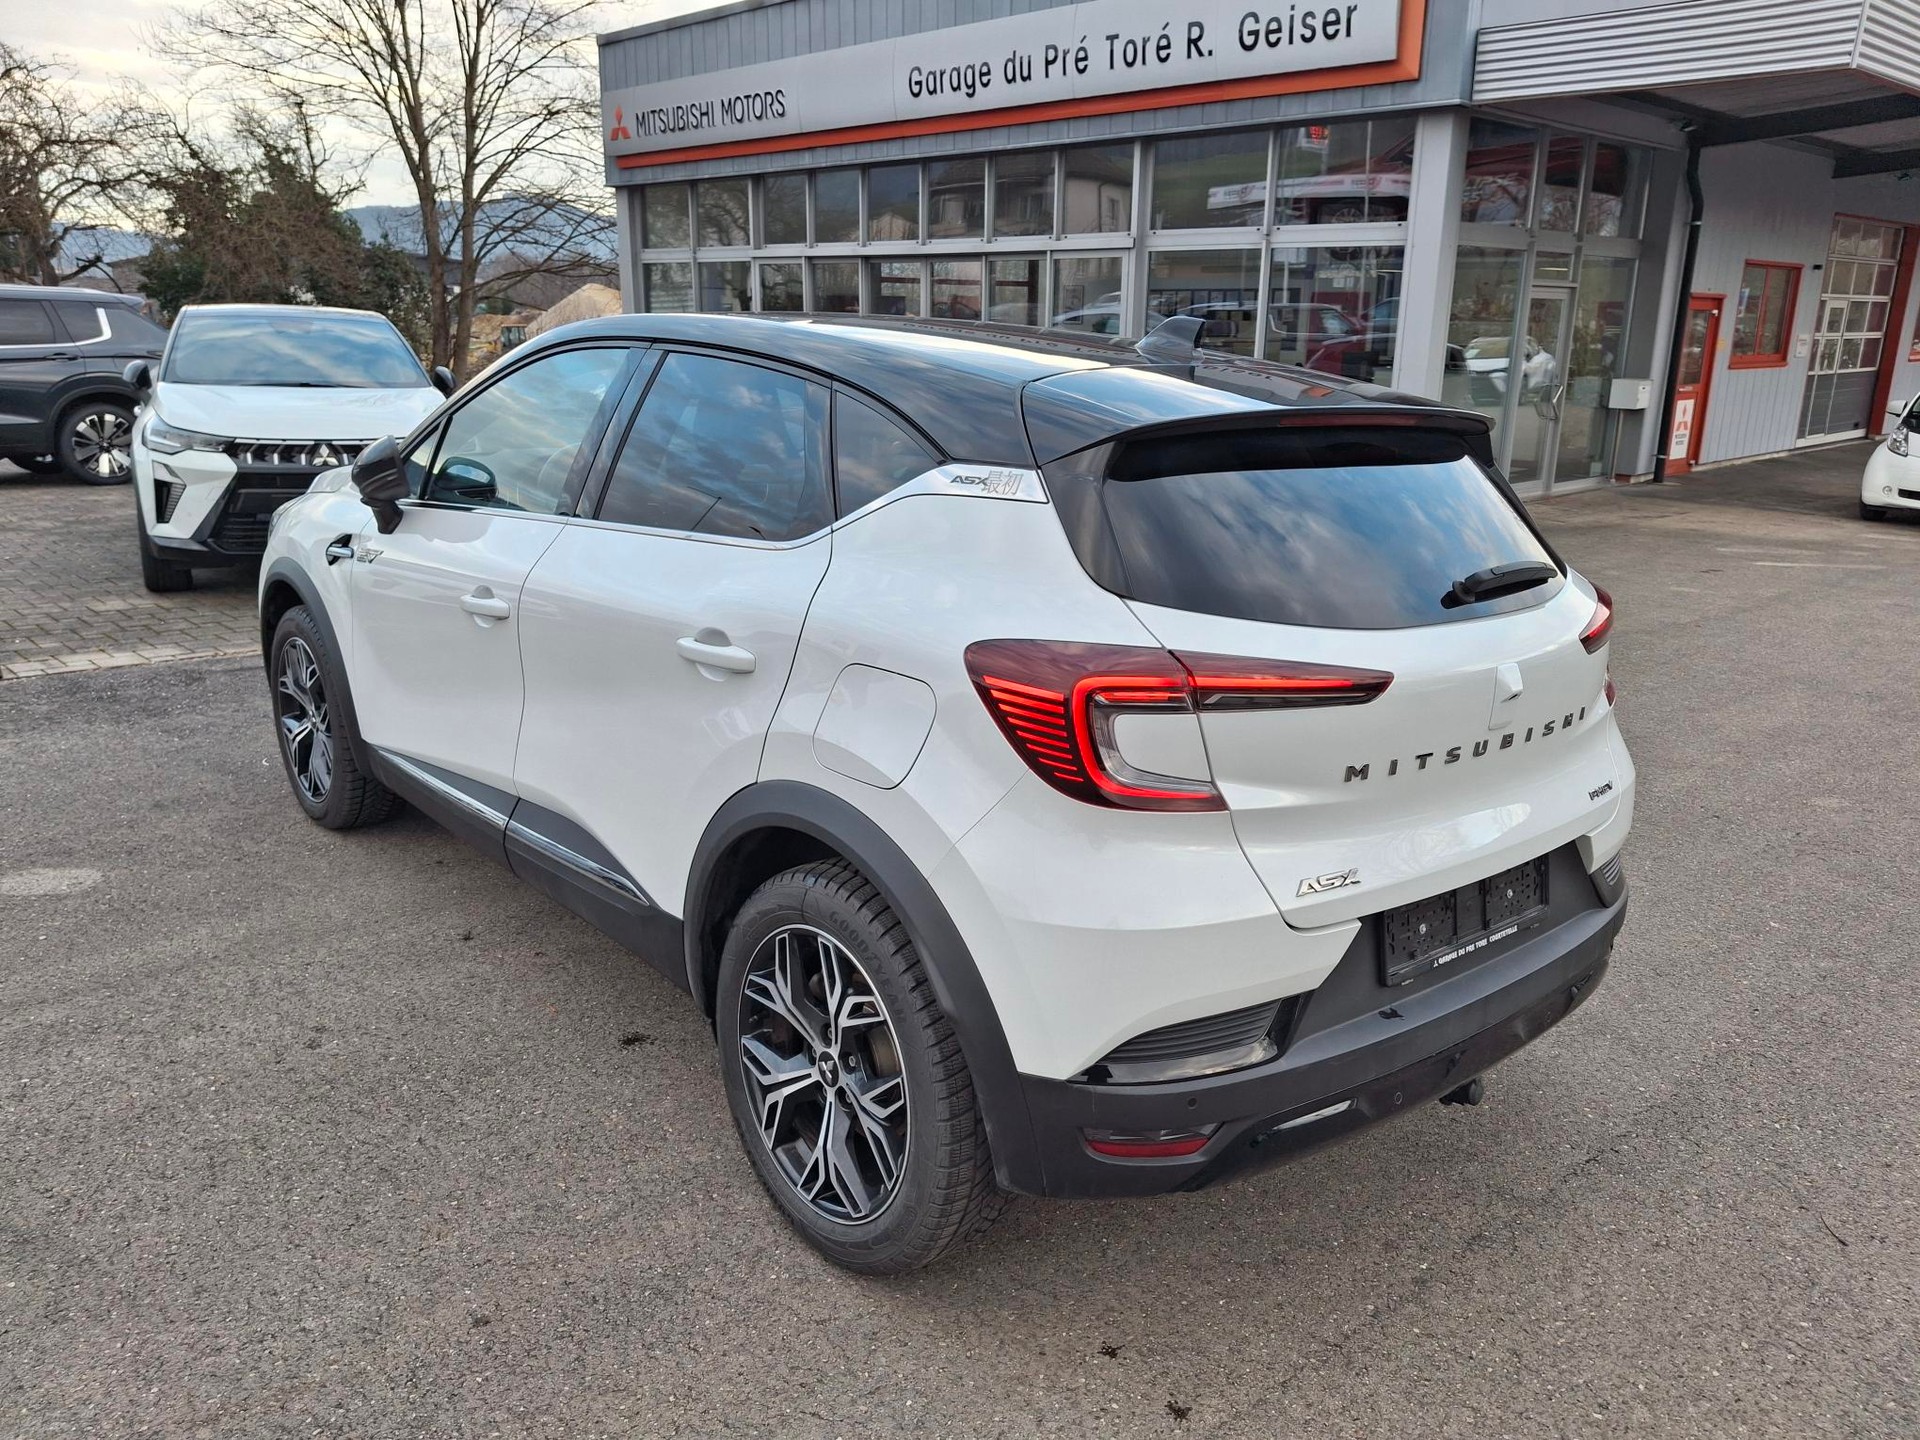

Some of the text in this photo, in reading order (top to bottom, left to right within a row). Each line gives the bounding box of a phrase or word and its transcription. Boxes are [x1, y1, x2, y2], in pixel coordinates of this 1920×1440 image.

[908, 4, 1358, 98] Garage du Pré Toré R. Geiser
[635, 89, 786, 138] MITSUBISHI MOTORS
[950, 475, 989, 487] ASX
[1344, 706, 1586, 783] MITSUBISHI
[1295, 867, 1362, 898] ASX
